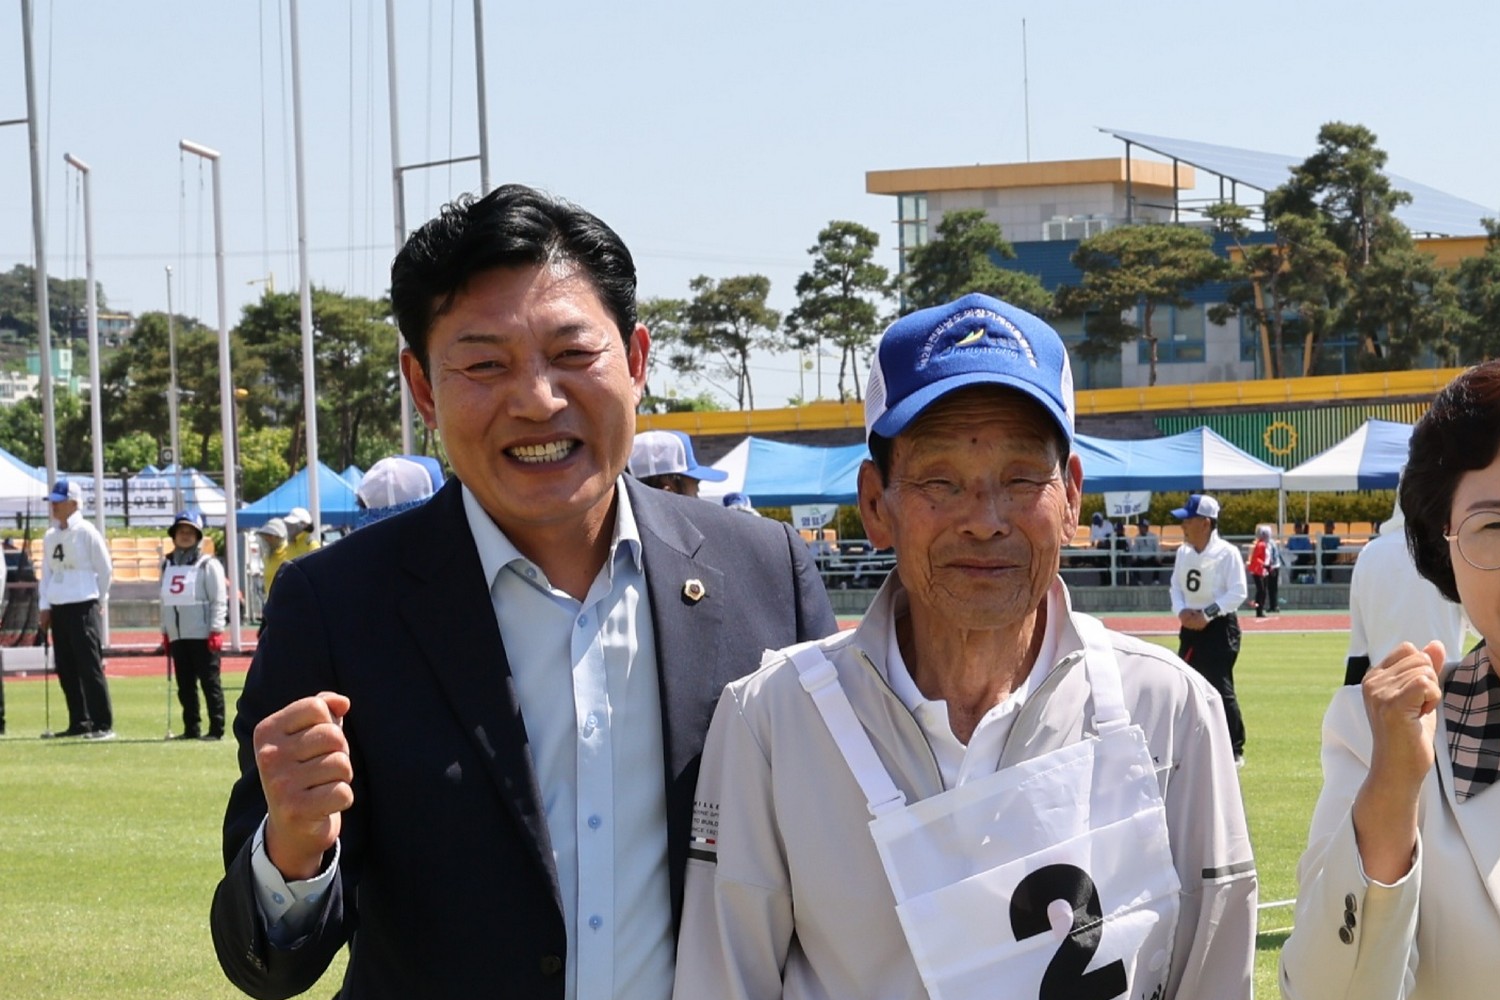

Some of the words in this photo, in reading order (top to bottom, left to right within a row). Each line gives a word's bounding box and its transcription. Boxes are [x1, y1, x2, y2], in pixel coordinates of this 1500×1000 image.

[52, 543, 65, 562] 4
[169, 575, 186, 595] 5
[1186, 569, 1202, 592] 6
